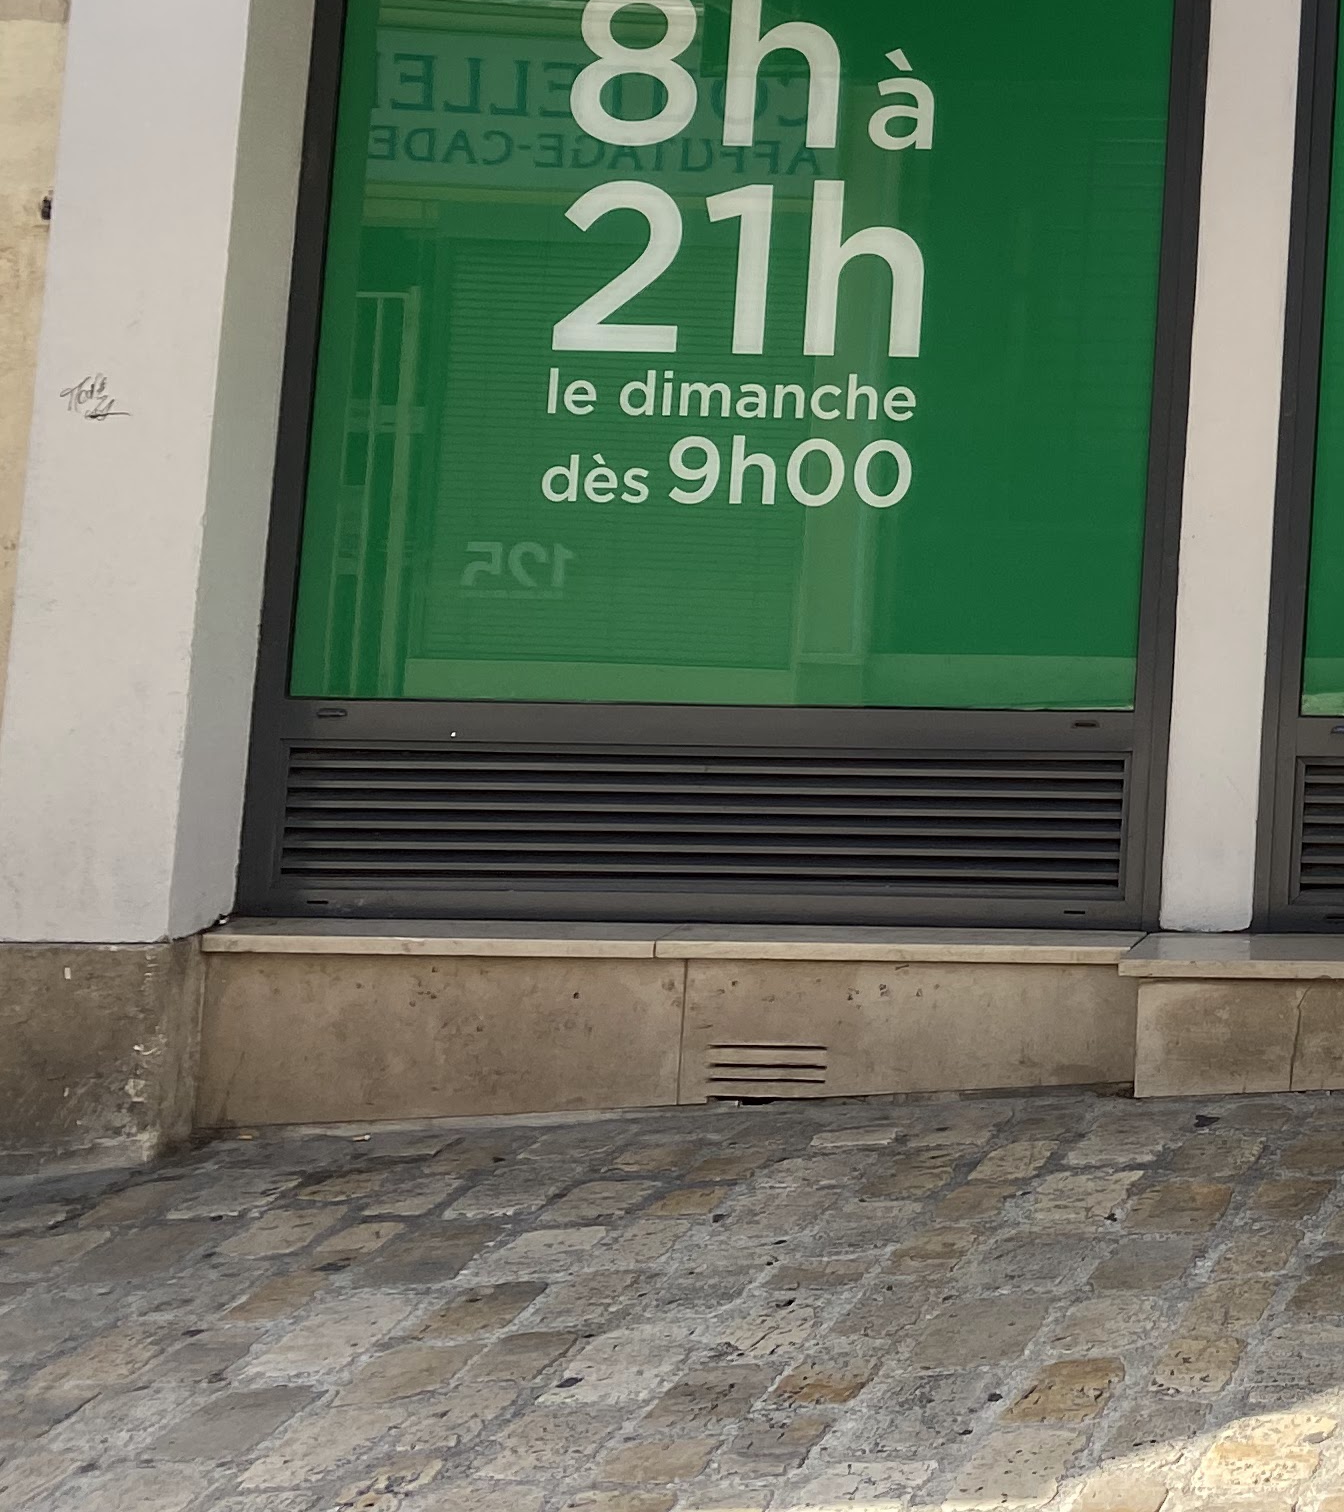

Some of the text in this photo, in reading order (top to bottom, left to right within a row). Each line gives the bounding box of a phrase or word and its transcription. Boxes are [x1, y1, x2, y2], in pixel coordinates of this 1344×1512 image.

[868, 49, 936, 152] à
[551, 180, 925, 359] 21h
[546, 367, 917, 422] le dimanche
[541, 436, 912, 508] dès 9h00
